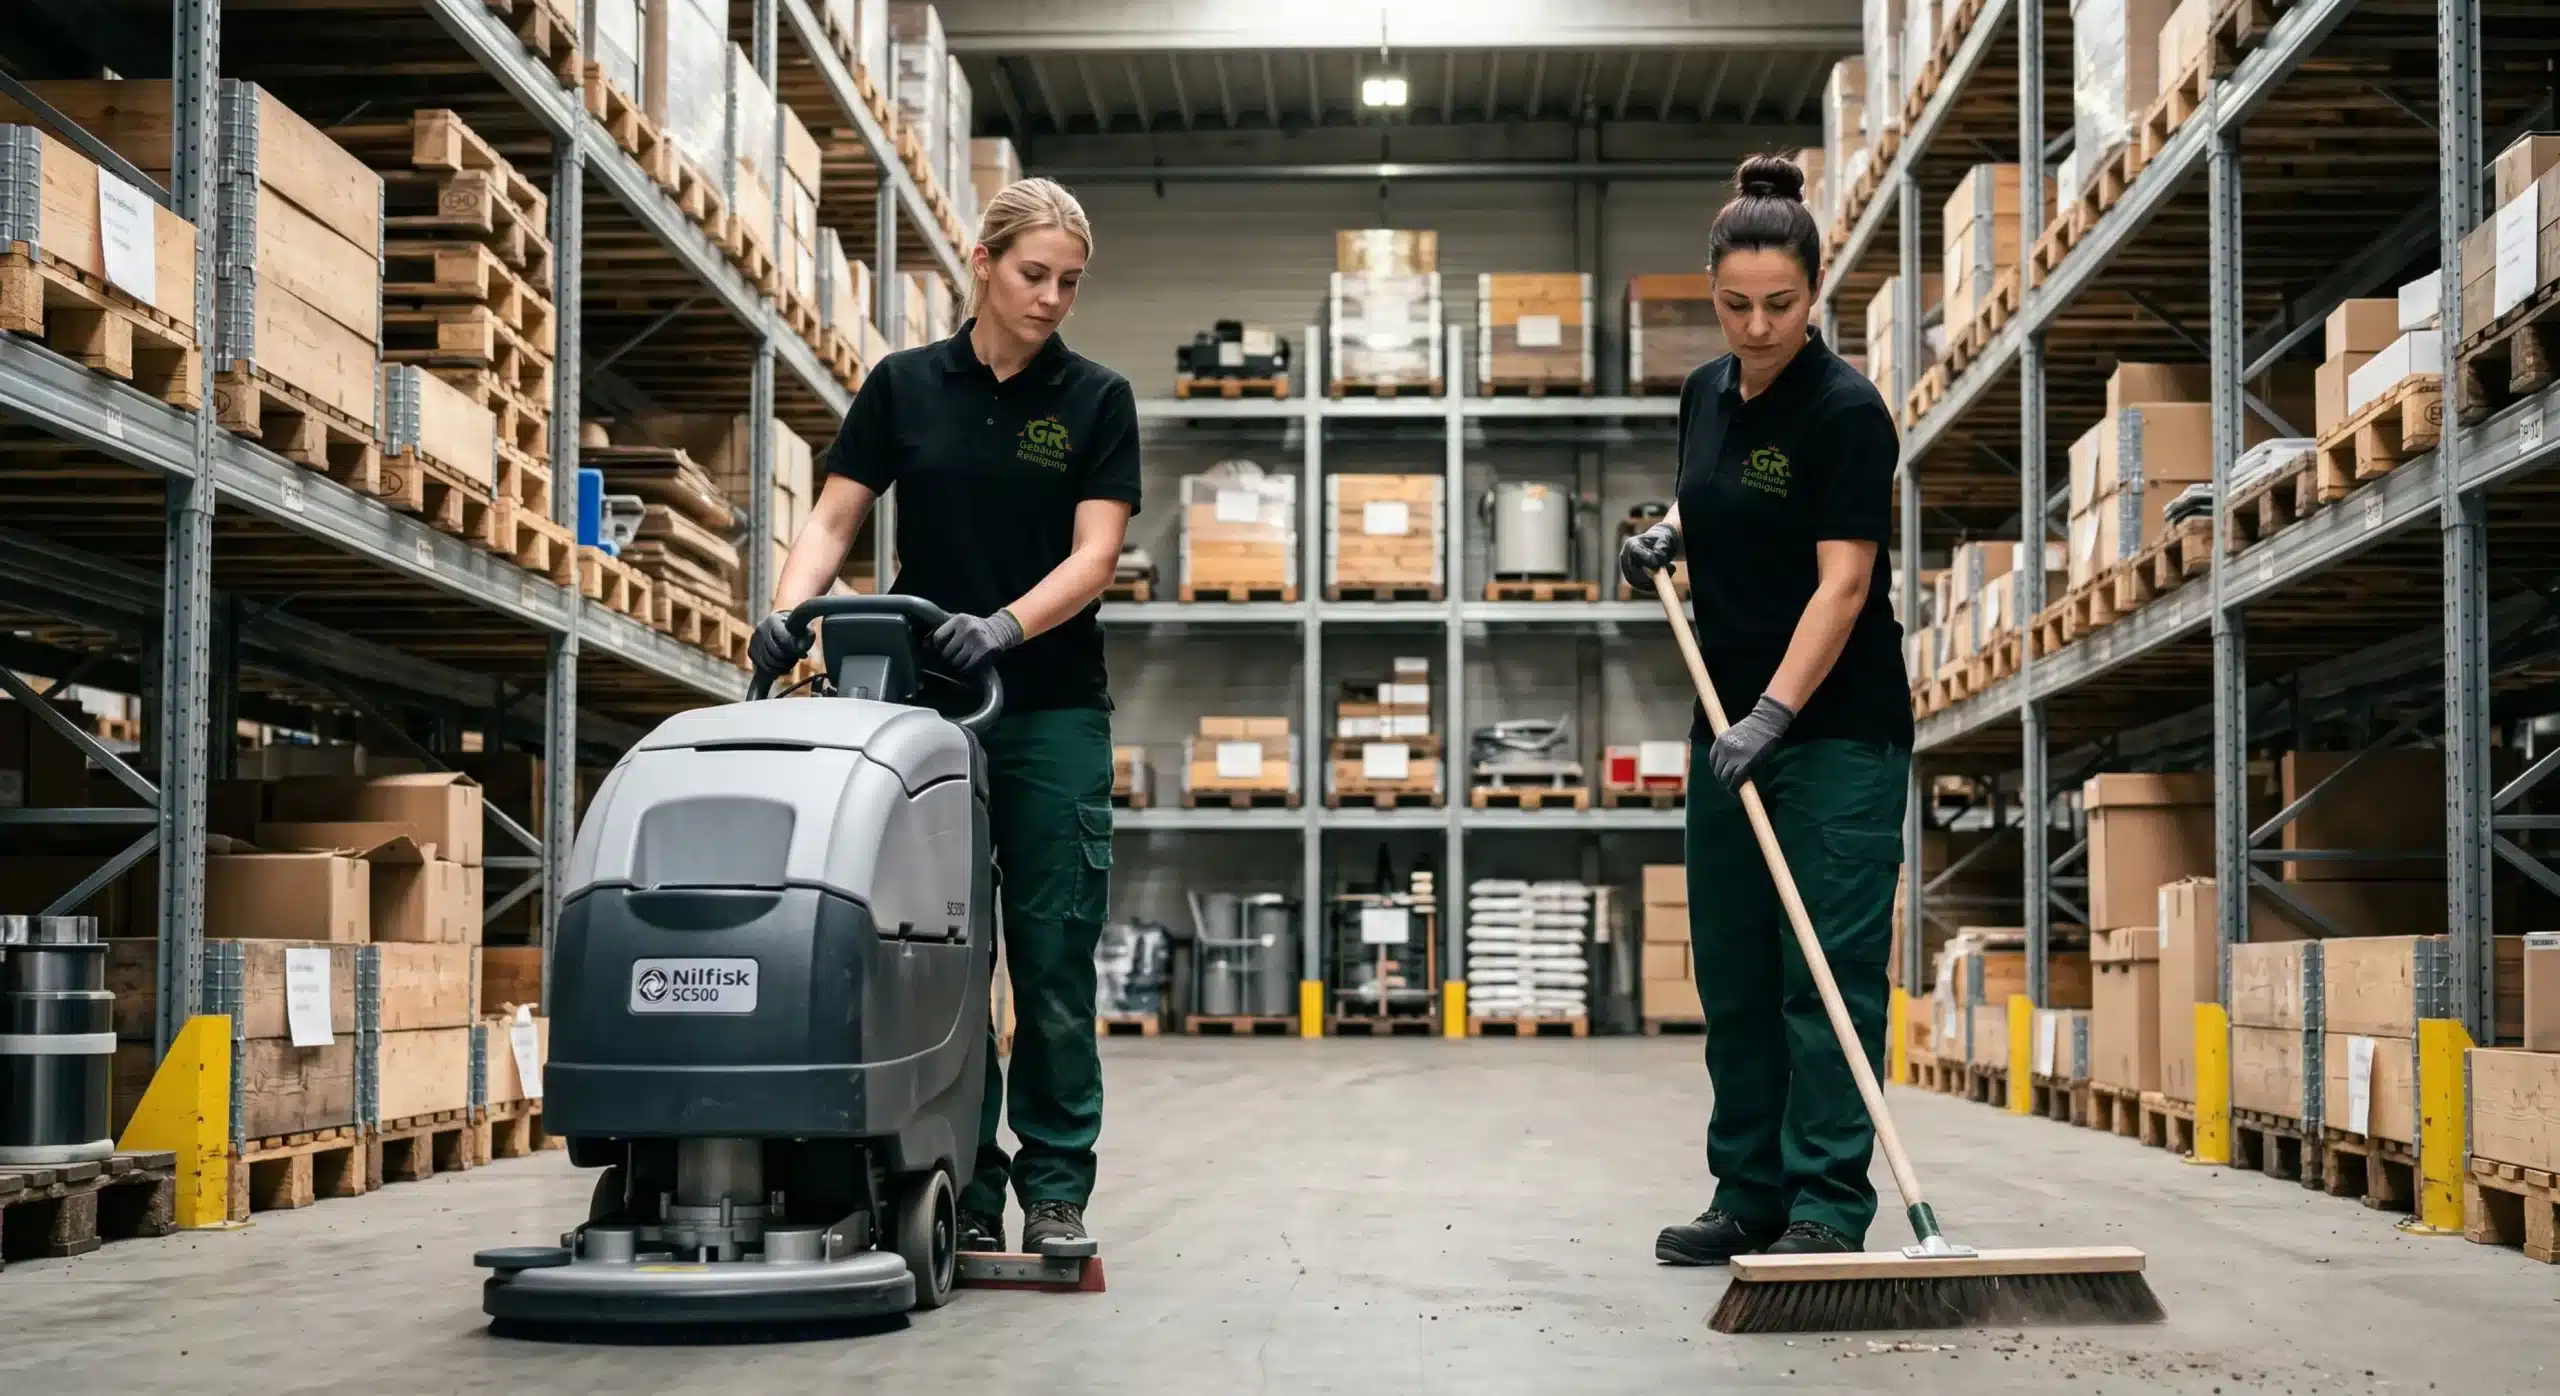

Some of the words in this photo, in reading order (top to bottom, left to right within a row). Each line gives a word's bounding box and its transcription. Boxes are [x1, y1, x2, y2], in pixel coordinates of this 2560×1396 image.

[1028, 419, 1065, 451] GR
[1016, 449, 1067, 472] Reinigung
[1752, 449, 1786, 477] GR
[1740, 476, 1788, 498] Reinigung
[672, 968, 750, 986] Nilfisk
[672, 988, 719, 1002] SC500
